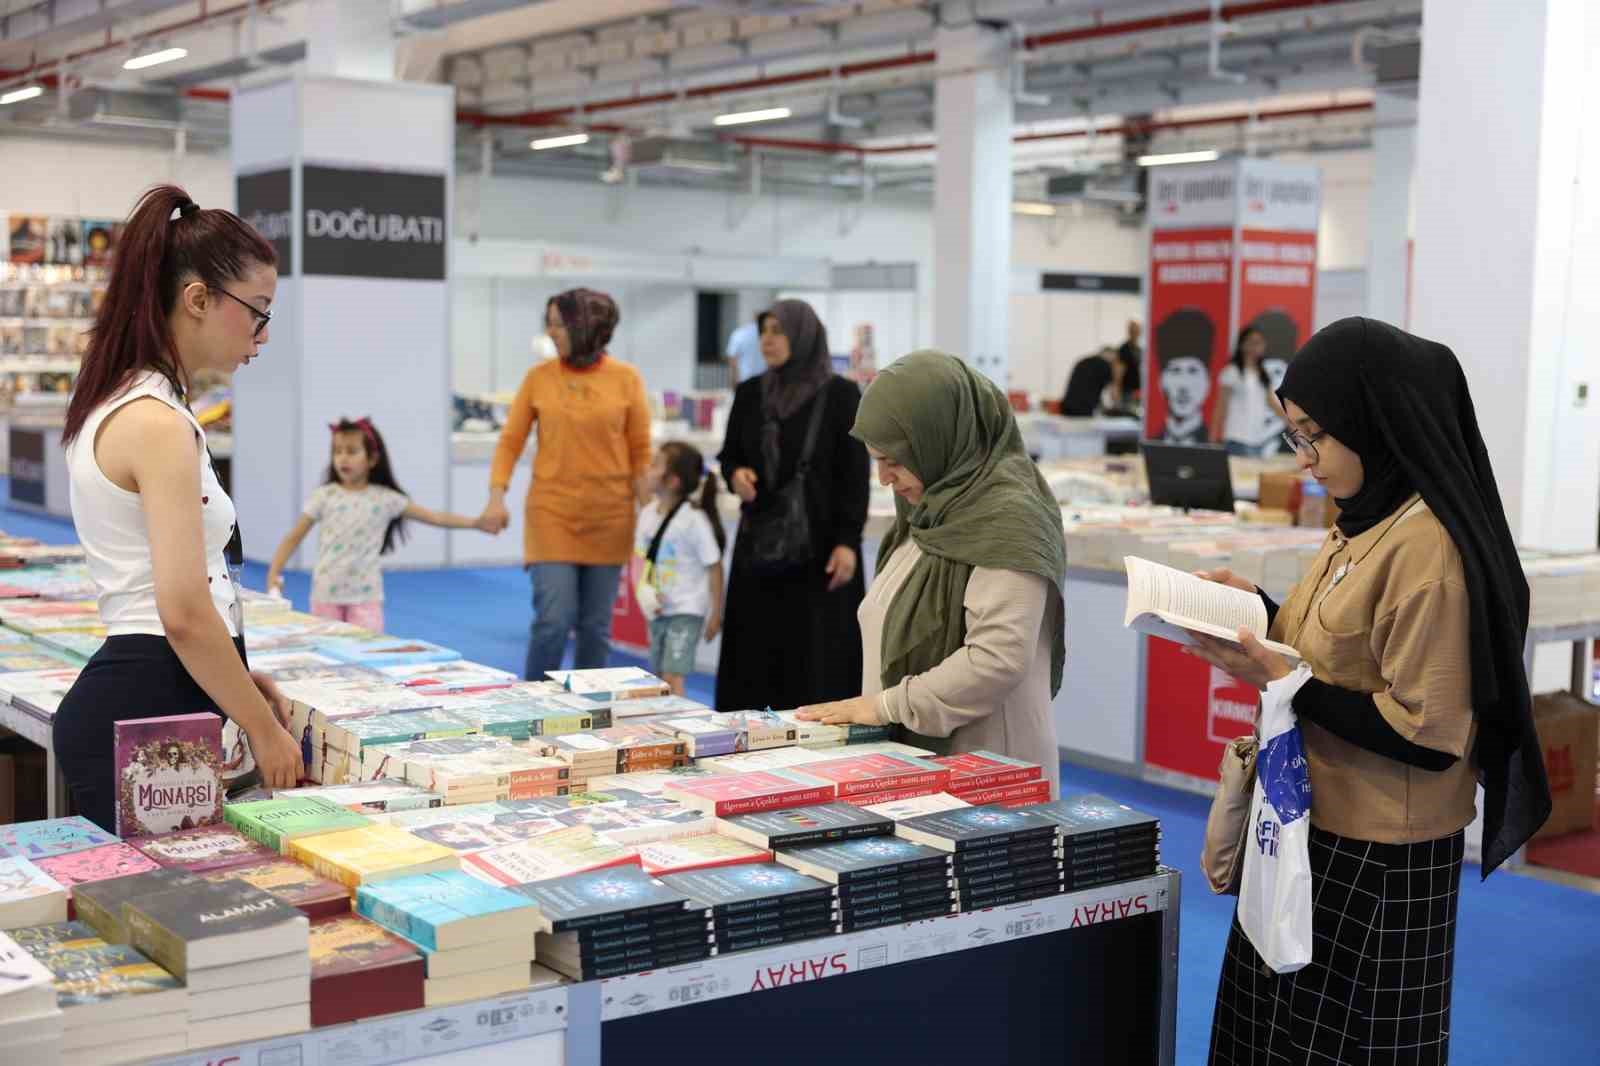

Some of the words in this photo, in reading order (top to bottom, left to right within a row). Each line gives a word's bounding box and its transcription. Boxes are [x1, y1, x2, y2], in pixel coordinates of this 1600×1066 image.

[307, 205, 443, 244] DOĞUBATI
[199, 898, 278, 923] ALAMUT
[1070, 896, 1148, 928] SARAY
[751, 953, 848, 992] SARAY
